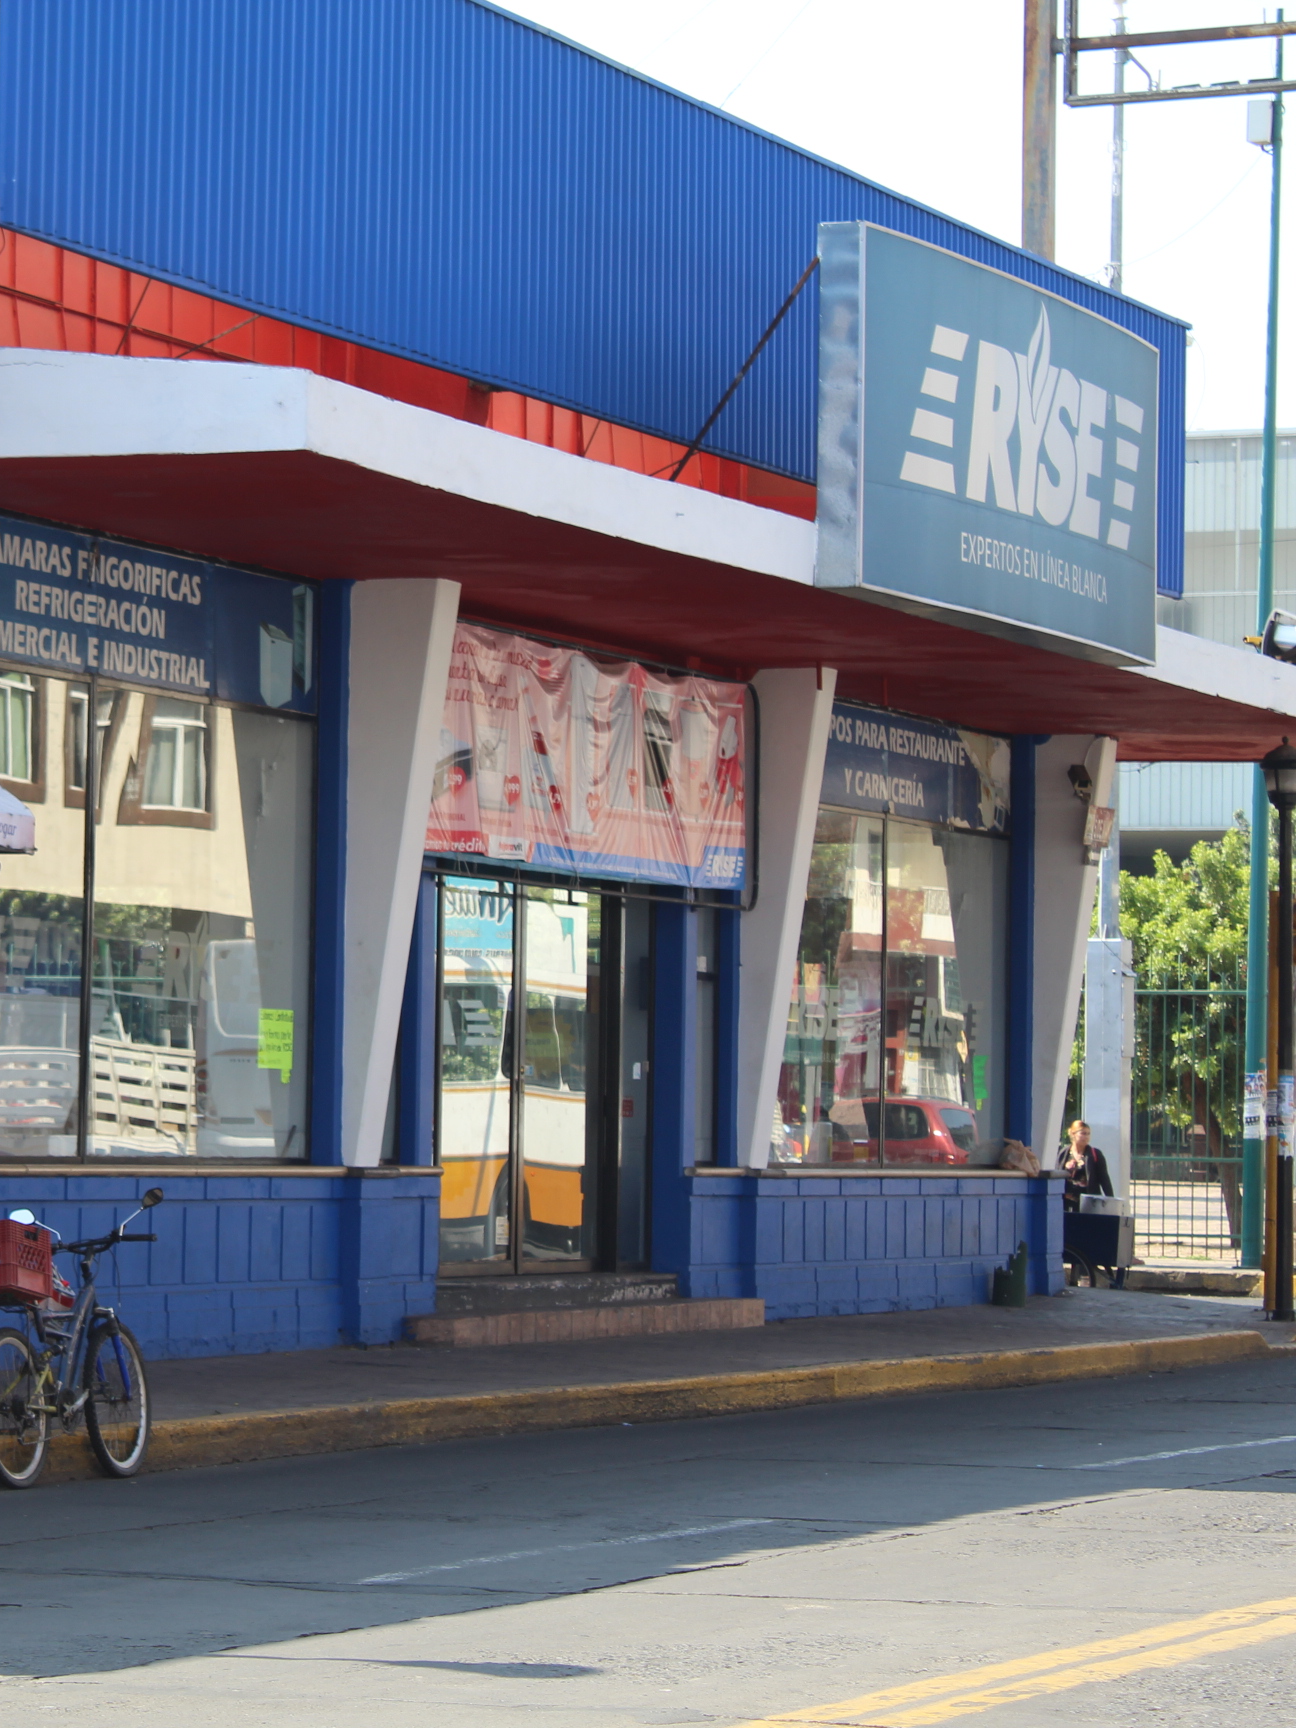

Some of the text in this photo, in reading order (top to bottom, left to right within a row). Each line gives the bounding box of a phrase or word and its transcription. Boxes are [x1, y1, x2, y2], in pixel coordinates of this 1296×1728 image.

[966, 302, 1107, 540] RYSE
[77, 549, 202, 606] FRIGORIFICAS
[961, 532, 1108, 604] EXPERTOS EN LÍNEA BLANCA
[15, 579, 166, 640] REFRIGERACIÓN
[87, 636, 100, 668] E
[104, 640, 211, 689] INDUSTRIAL
[855, 720, 889, 751] PARA
[889, 727, 966, 767] RESTAURANTE
[844, 767, 925, 808] Y CARNICERÍA
